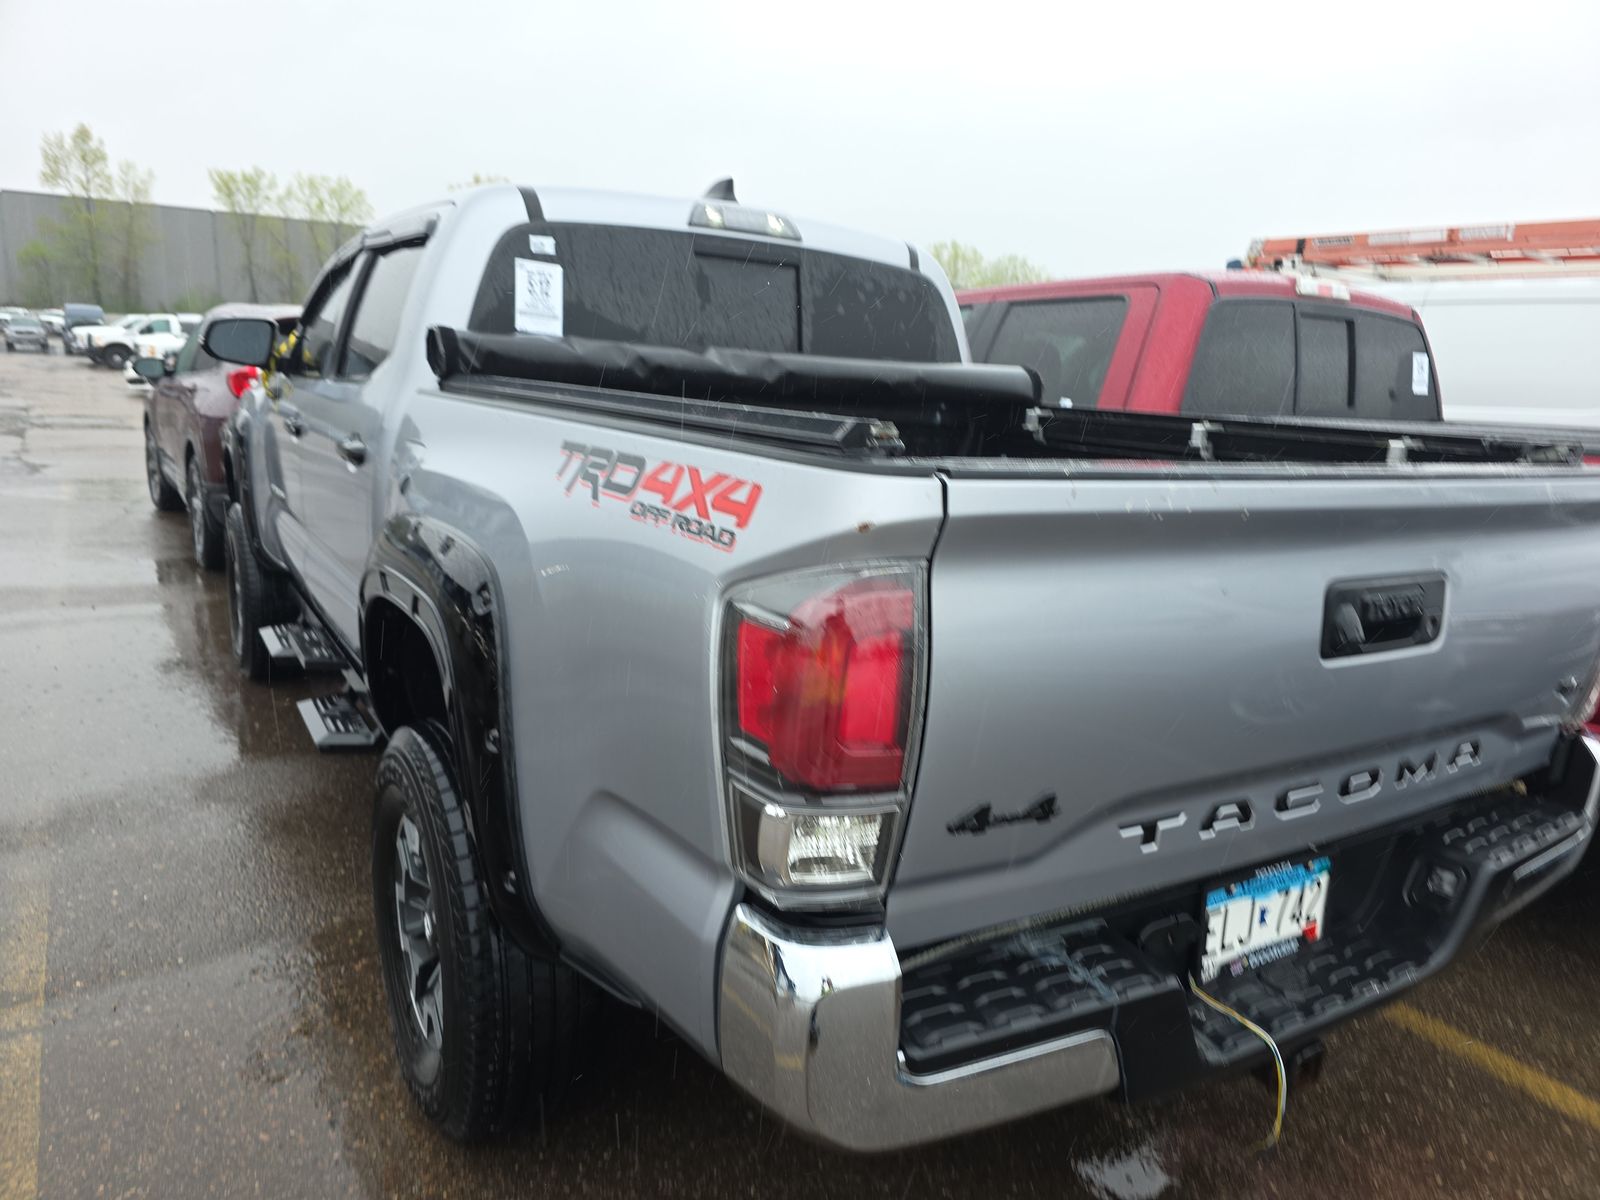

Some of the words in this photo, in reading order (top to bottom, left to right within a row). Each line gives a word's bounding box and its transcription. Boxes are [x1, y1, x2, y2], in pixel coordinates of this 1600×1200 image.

[556, 440, 646, 507] TRD
[629, 500, 672, 527] OFF
[671, 512, 737, 553] ROAD
[1118, 739, 1482, 854] TACOMA
